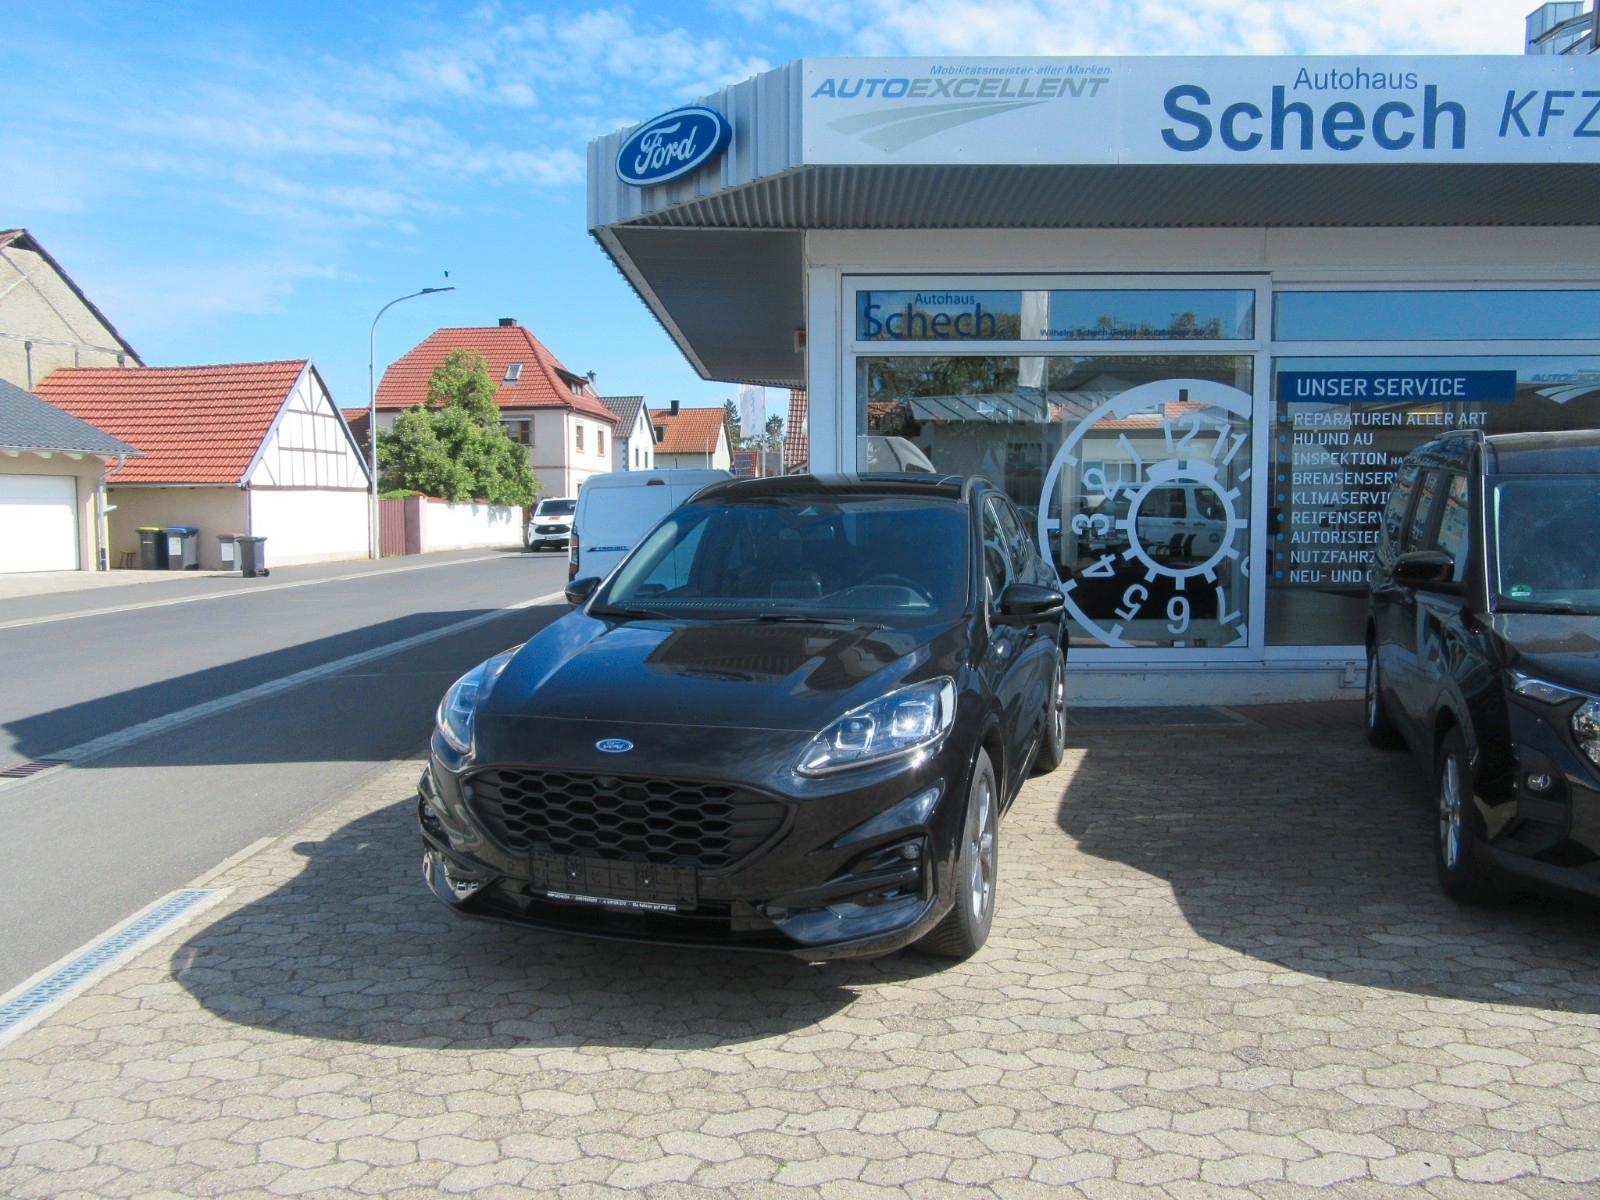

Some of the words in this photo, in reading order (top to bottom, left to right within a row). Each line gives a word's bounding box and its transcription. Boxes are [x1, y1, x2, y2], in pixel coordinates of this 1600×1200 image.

[1037, 65, 1063, 75] aller
[1066, 65, 1111, 75] Marken
[1293, 67, 1419, 90] Autohaus
[810, 78, 1110, 98] AUTOEXCELLENT
[1160, 84, 1466, 151] Schech
[634, 120, 698, 174] Ford
[914, 293, 976, 305] Autohaus
[863, 302, 996, 338] Schech
[1296, 377, 1368, 397] UNSER
[1373, 376, 1467, 396] SERVICE
[1293, 412, 1402, 426] REPARATUREN
[1406, 411, 1454, 426] ALLER
[1458, 411, 1488, 426] ART
[1293, 432, 1314, 446] HU
[1318, 432, 1349, 446] UND
[1352, 432, 1374, 446] AU
[1293, 452, 1387, 465] INSPEKTION
[1390, 456, 1404, 465] NA
[1289, 570, 1327, 583] NEU-
[1331, 570, 1362, 583] UND
